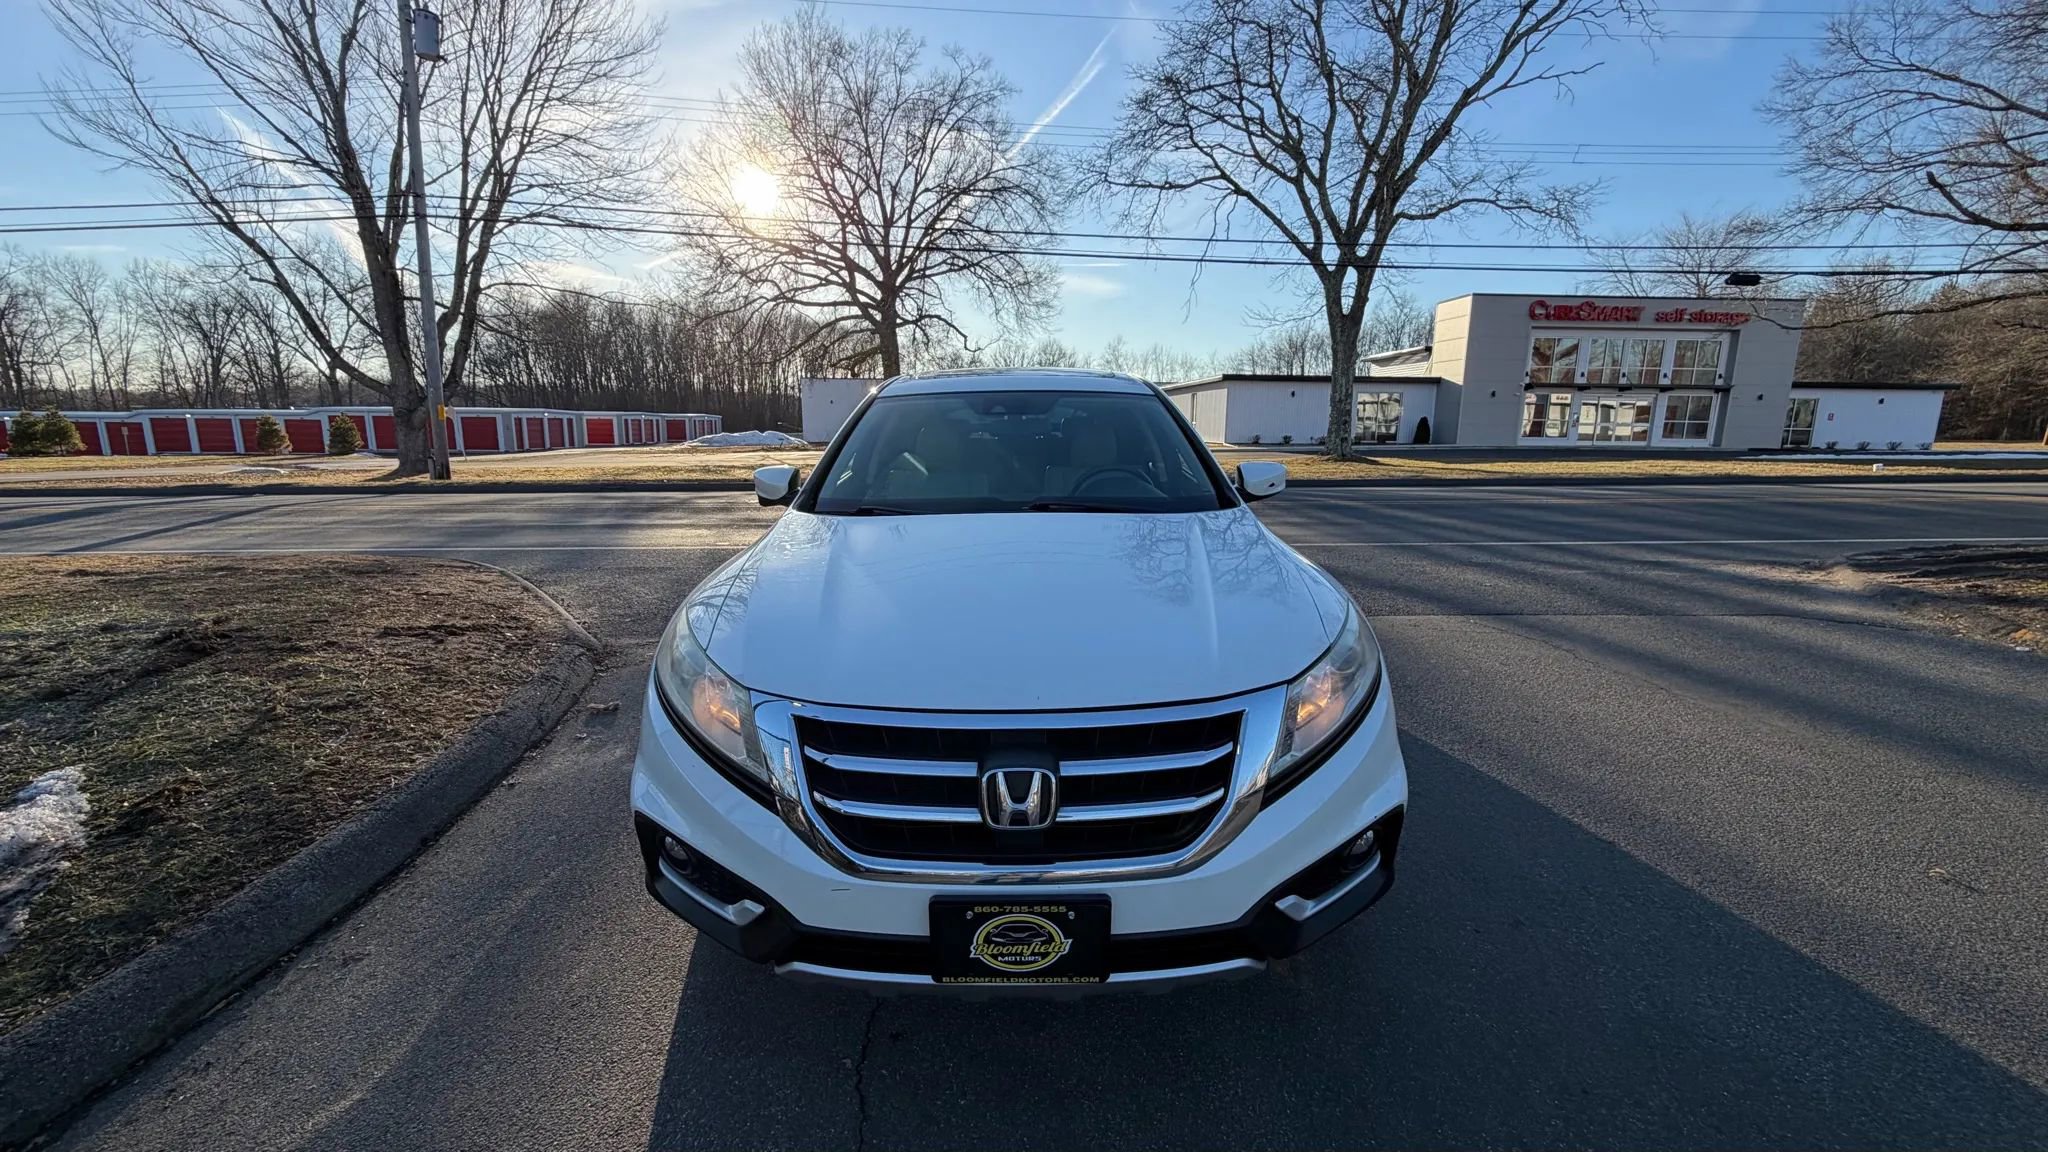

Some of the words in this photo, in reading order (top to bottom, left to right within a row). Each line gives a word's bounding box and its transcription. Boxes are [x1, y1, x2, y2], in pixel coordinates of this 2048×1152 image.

[1656, 308, 1688, 322] self
[973, 905, 1067, 913] 860-785-5555
[975, 941, 1068, 956] Bloomfield
[942, 976, 1100, 984] BLOOMFIELDMOTORS.COM
